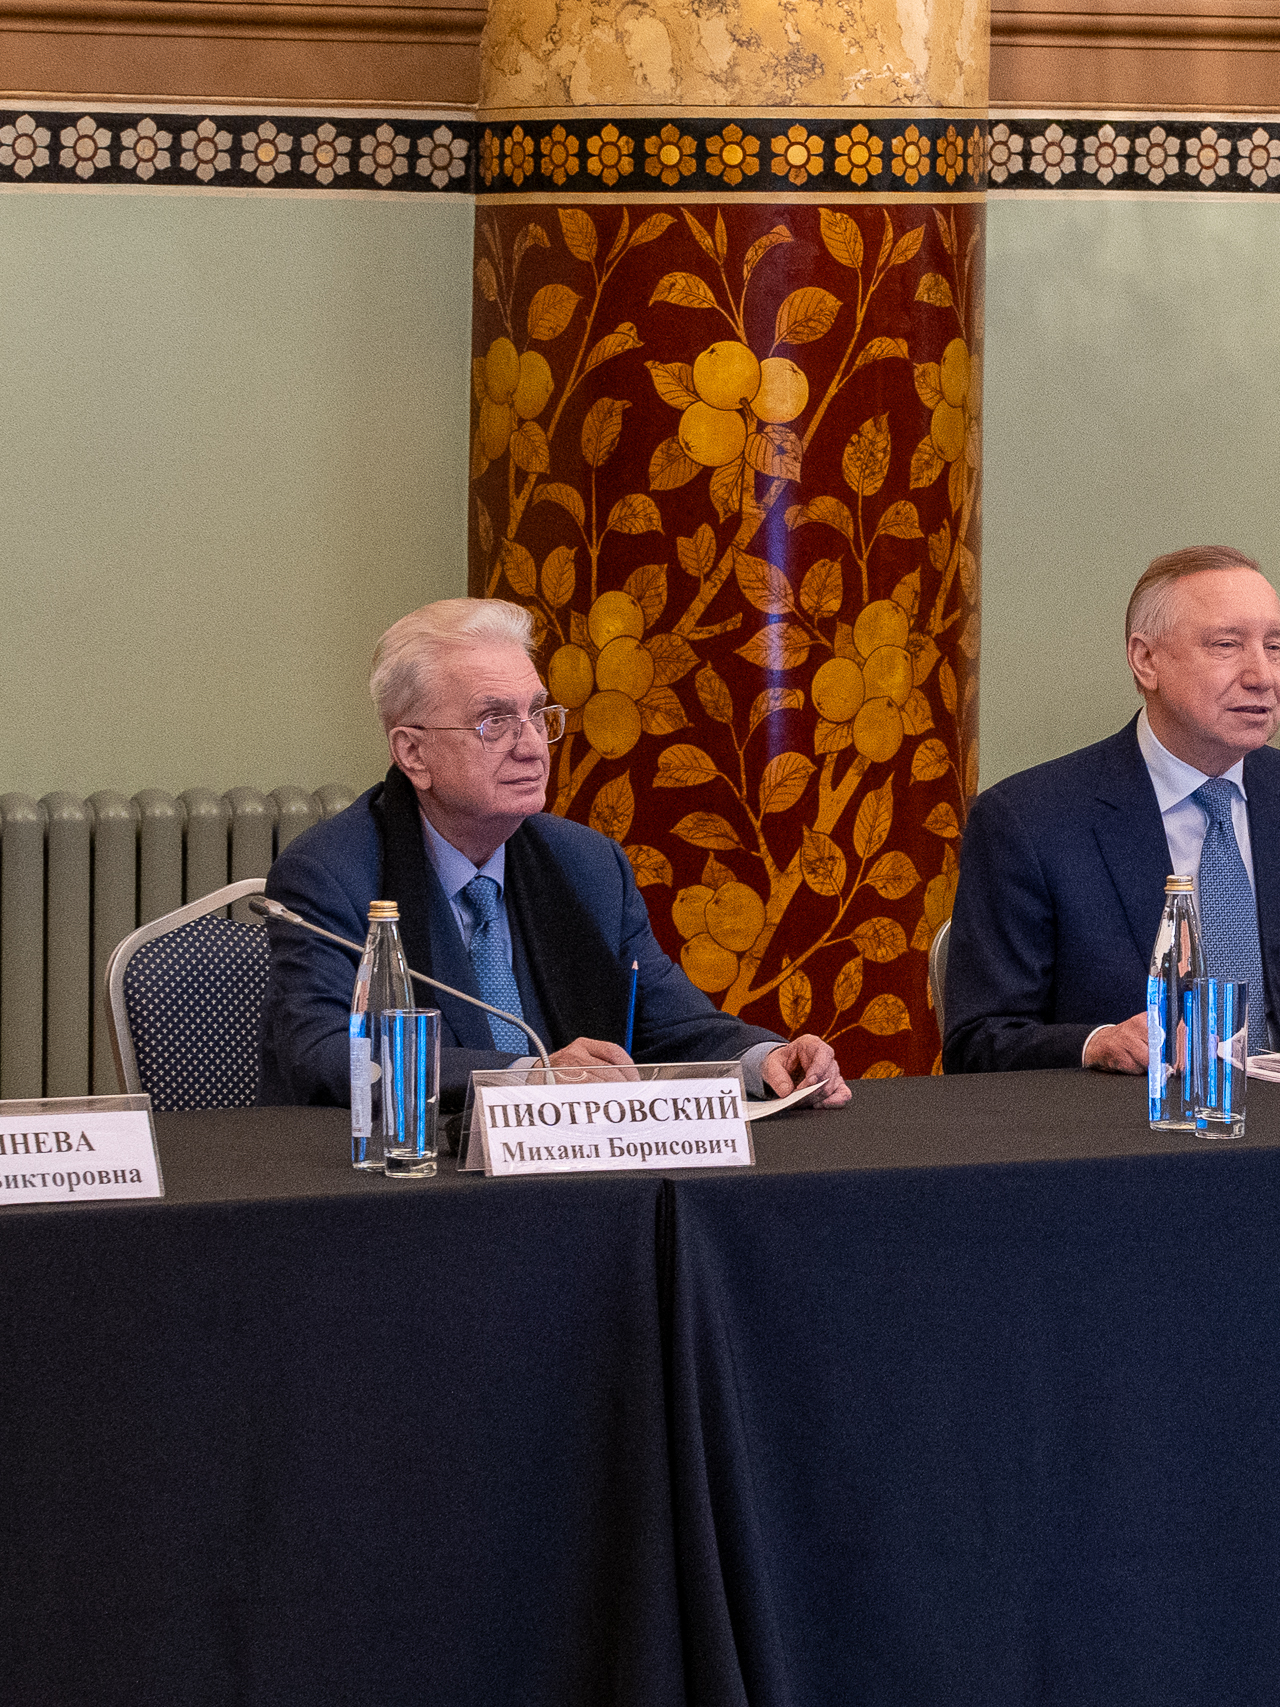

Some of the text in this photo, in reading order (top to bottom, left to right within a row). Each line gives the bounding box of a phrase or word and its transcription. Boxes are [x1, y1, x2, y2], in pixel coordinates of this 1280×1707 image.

[486, 1089, 742, 1129] ПИОТРОВСКИЙ
[501, 1136, 738, 1163] Михаил Борисович
[0, 1167, 143, 1192] икторовна
